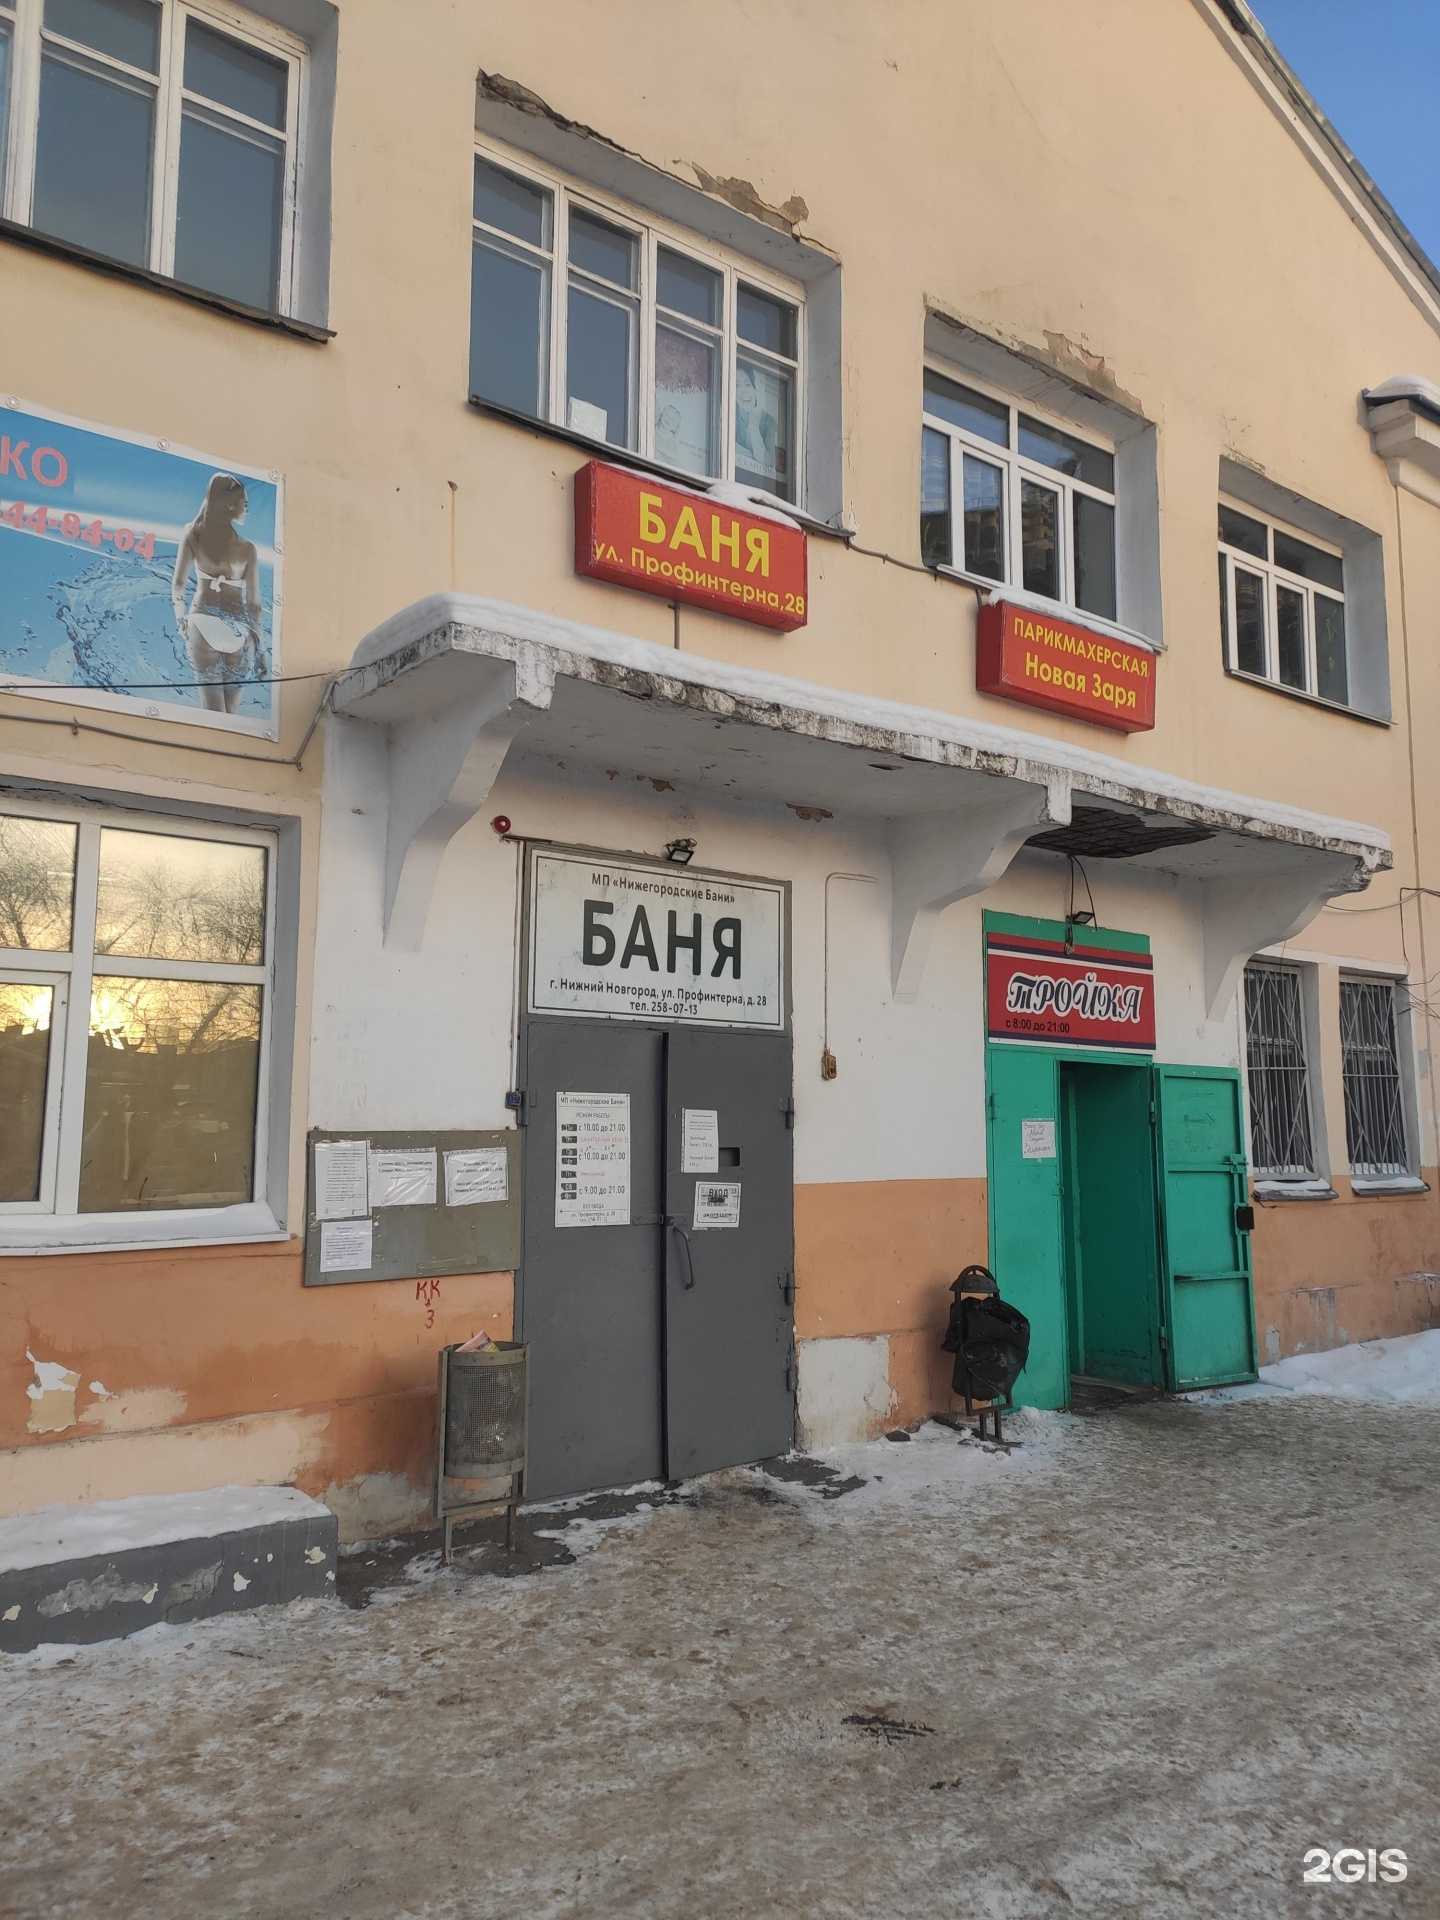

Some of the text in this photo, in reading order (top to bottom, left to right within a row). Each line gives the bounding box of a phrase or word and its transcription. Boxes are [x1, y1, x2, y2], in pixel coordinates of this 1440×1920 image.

[640, 491, 769, 577] БАНЯ
[594, 541, 623, 563] ул.
[1014, 617, 1149, 677] ПАРИКМАХЕРСКАЯ
[1025, 652, 1136, 708] Новая Заря
[592, 873, 735, 904] МП «Нижегородские Бани»
[582, 899, 742, 980] БАНЯ
[550, 978, 767, 1007] г. Нижний Новгород, ул. Профинтерна, д. 28
[630, 1001, 698, 1015] тел. 258-07-13
[1006, 1019, 1070, 1033] с 8:00 до 21:00
